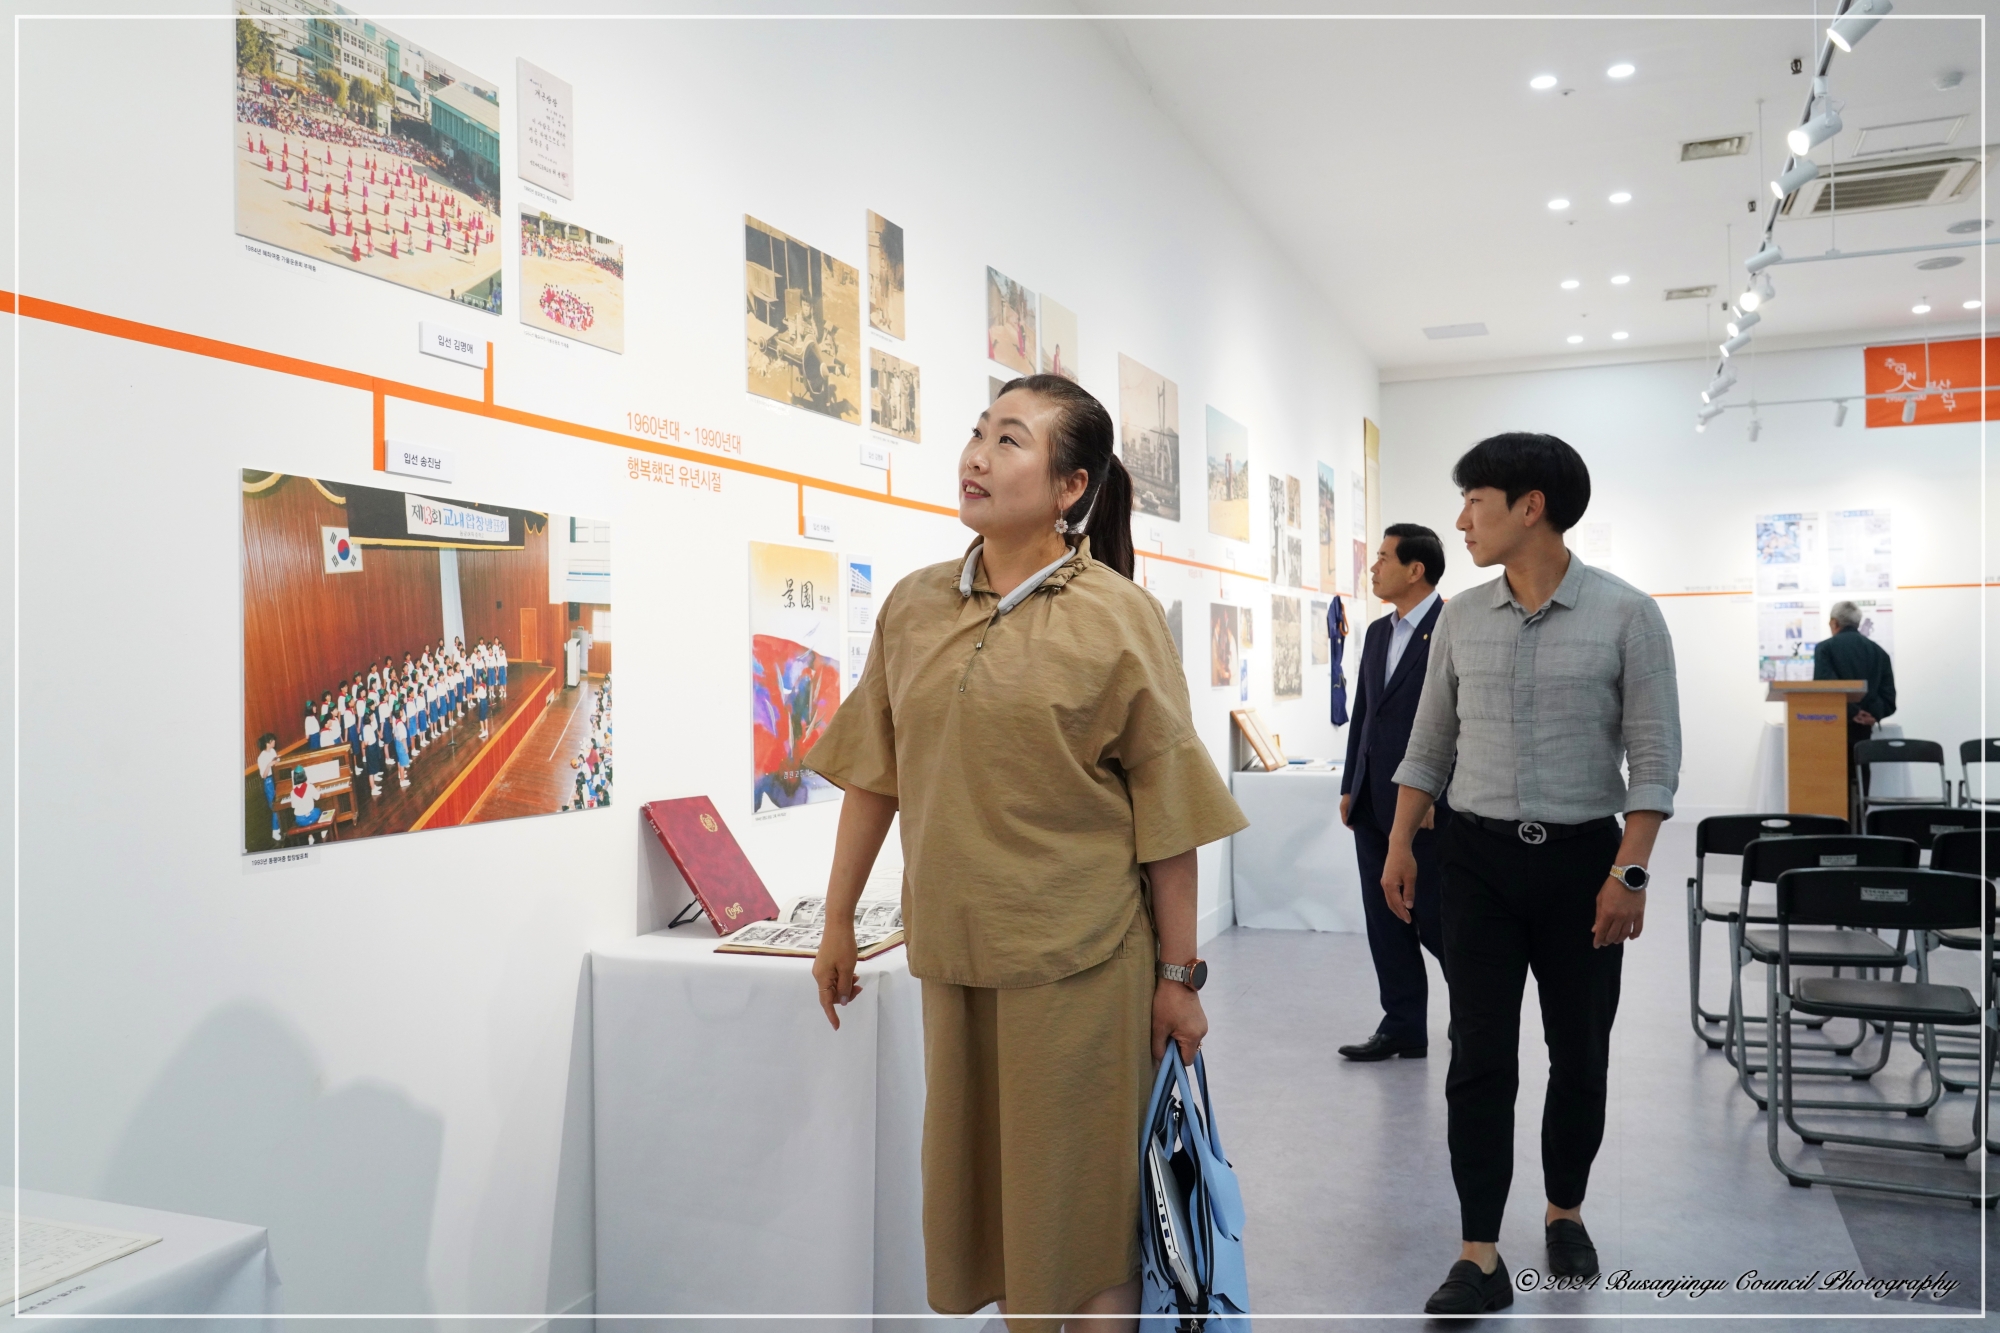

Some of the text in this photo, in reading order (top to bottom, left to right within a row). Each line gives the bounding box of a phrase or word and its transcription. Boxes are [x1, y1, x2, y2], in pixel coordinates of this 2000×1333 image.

[245, 245, 261, 256] 1984년
[437, 335, 474, 354] 입선 김명애
[627, 411, 680, 442] 1960년대
[694, 427, 742, 455] 1990년대
[404, 452, 441, 470] 입선 송진남
[627, 456, 722, 493] 행복했던 유년시절
[411, 503, 442, 526] 제13회
